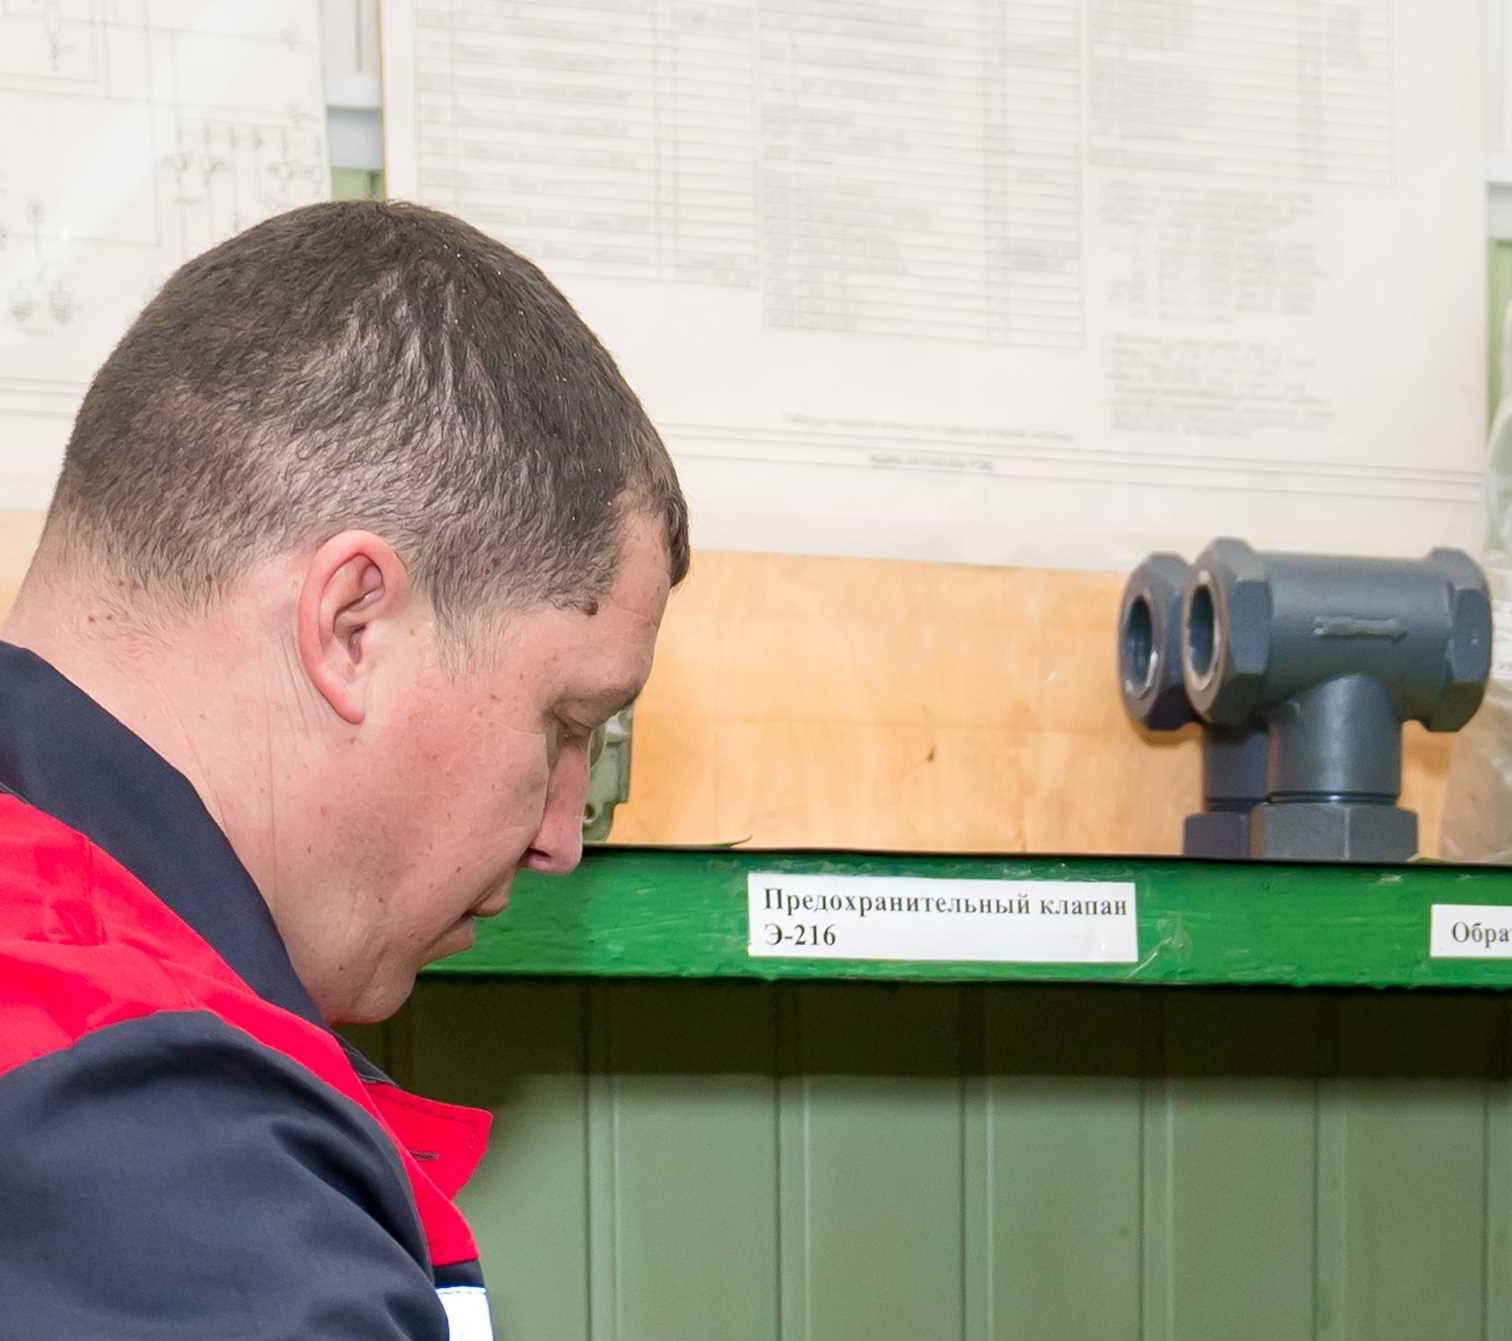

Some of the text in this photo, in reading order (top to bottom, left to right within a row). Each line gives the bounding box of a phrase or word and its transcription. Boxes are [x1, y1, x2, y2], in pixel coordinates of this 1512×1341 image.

[763, 888, 1128, 917] Предохранительный клапан
[764, 923, 837, 946] Э-216
